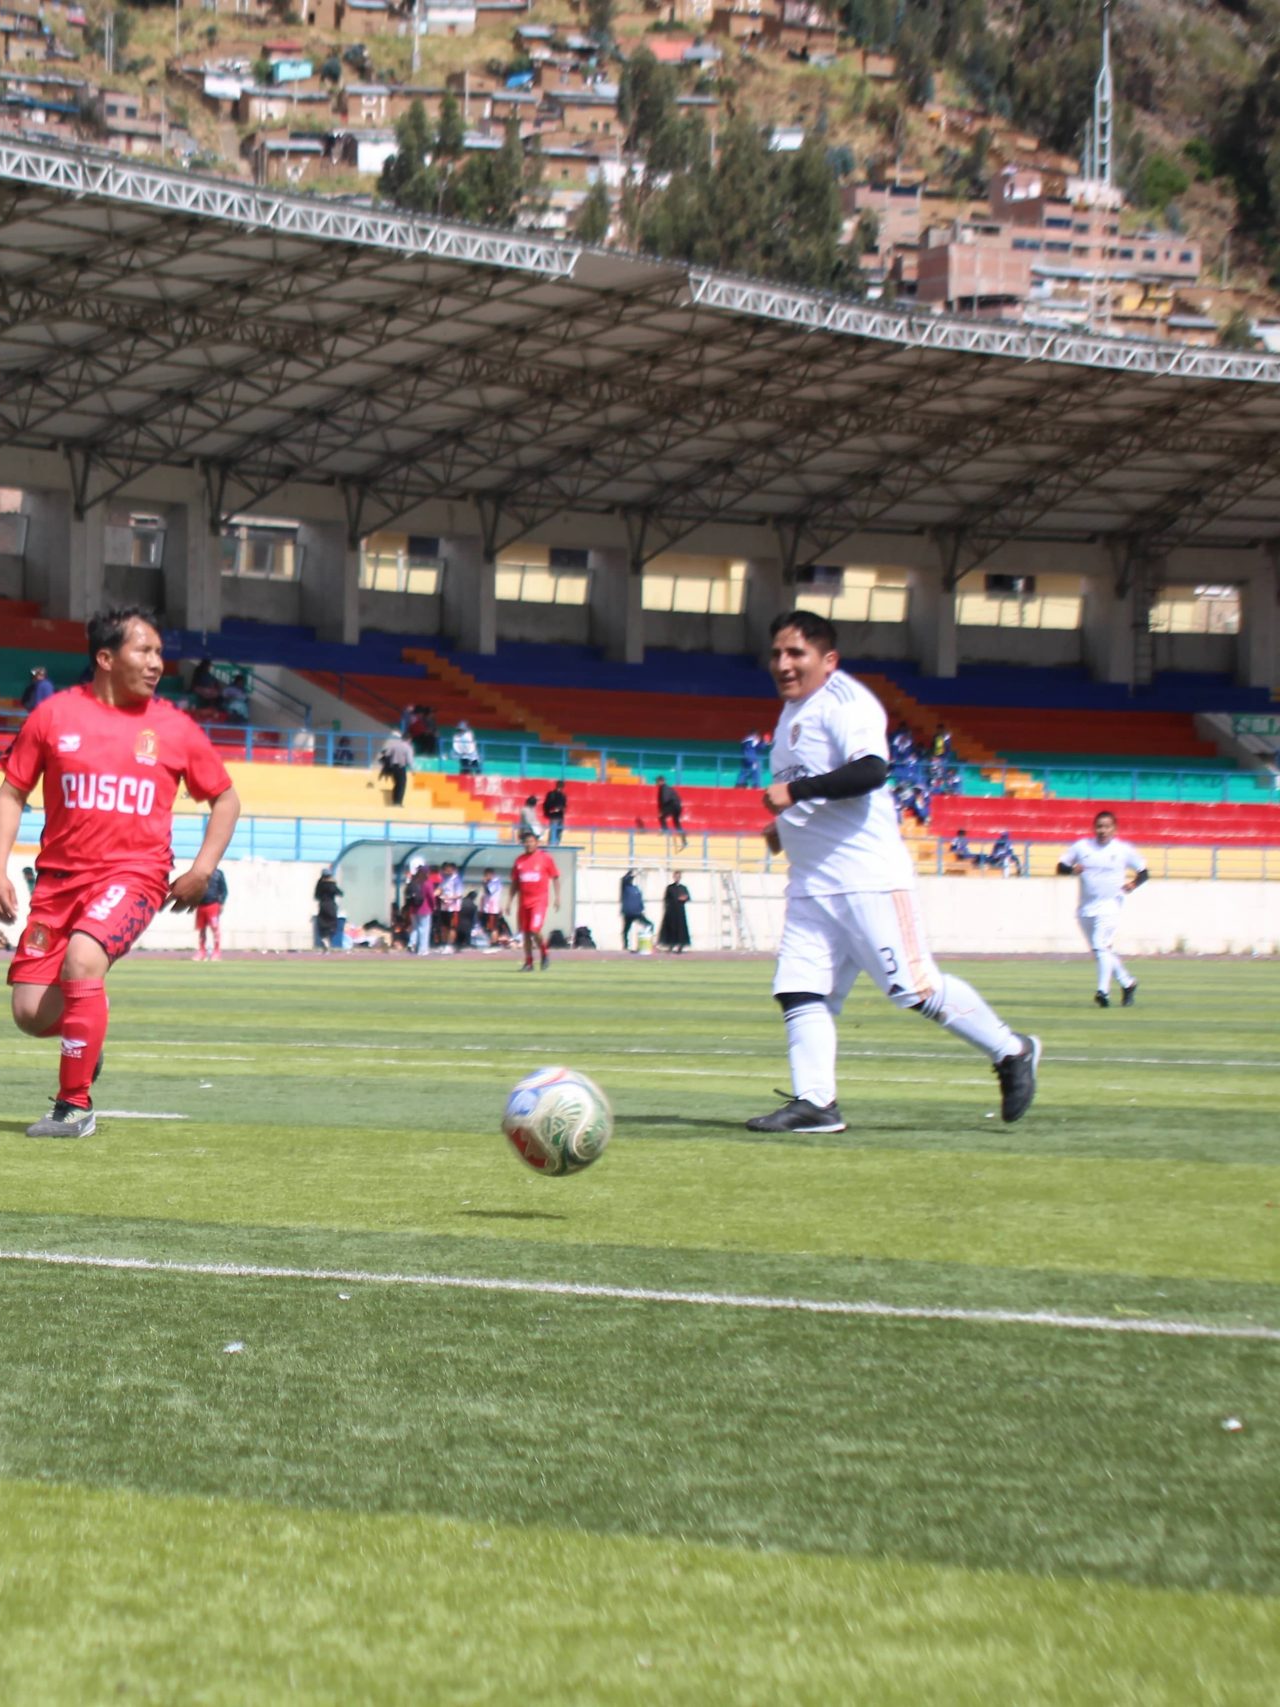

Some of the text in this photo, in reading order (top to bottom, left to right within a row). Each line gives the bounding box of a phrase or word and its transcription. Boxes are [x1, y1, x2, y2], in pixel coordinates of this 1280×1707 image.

[61, 773, 155, 816] CUSCO
[100, 884, 127, 909] 9
[879, 946, 898, 975] 3
